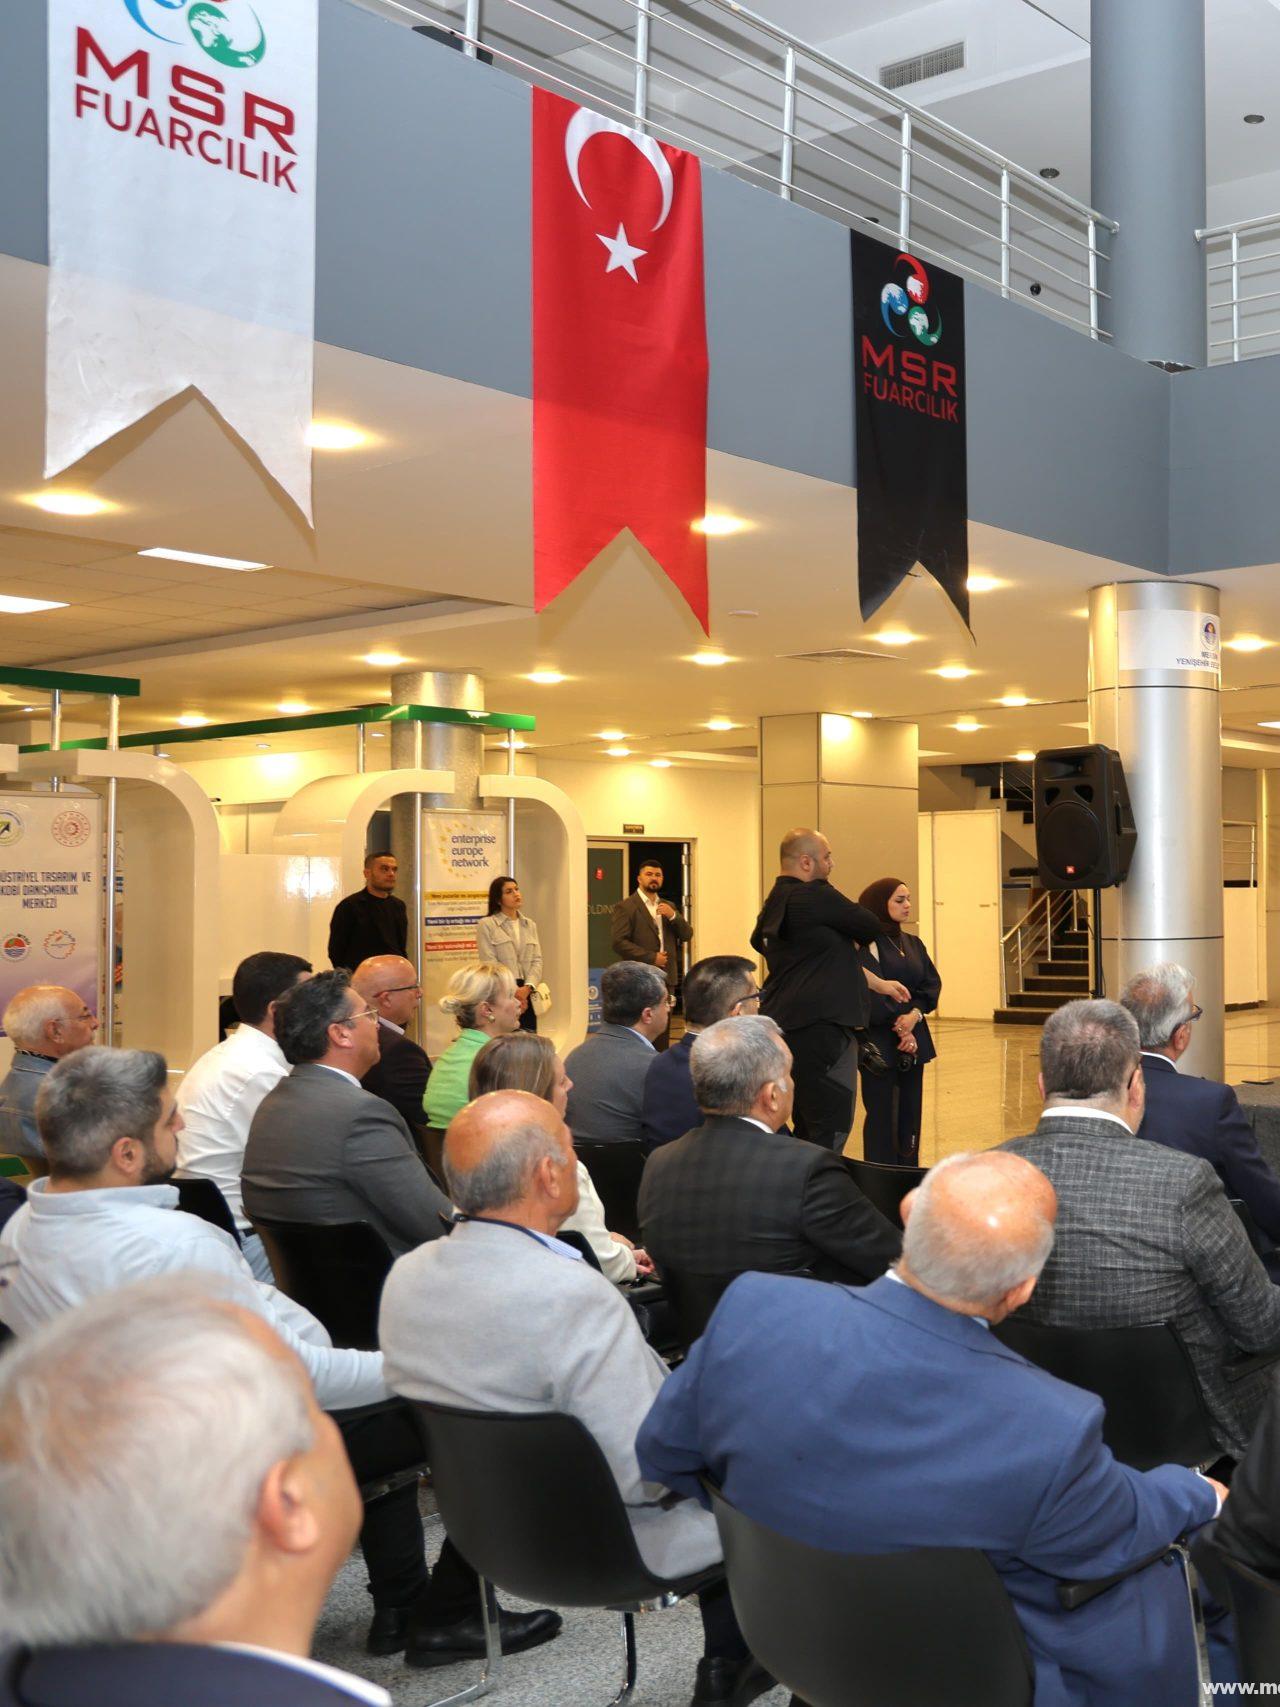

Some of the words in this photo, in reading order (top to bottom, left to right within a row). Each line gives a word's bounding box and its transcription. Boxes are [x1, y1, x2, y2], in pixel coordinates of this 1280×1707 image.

[76, 26, 298, 156] MSR
[75, 83, 298, 194] FUARCILIK
[861, 334, 958, 398] MSR
[863, 372, 959, 424] FUARCILIK
[451, 834, 496, 847] enterprise
[451, 847, 484, 860] europe
[451, 857, 489, 868] network
